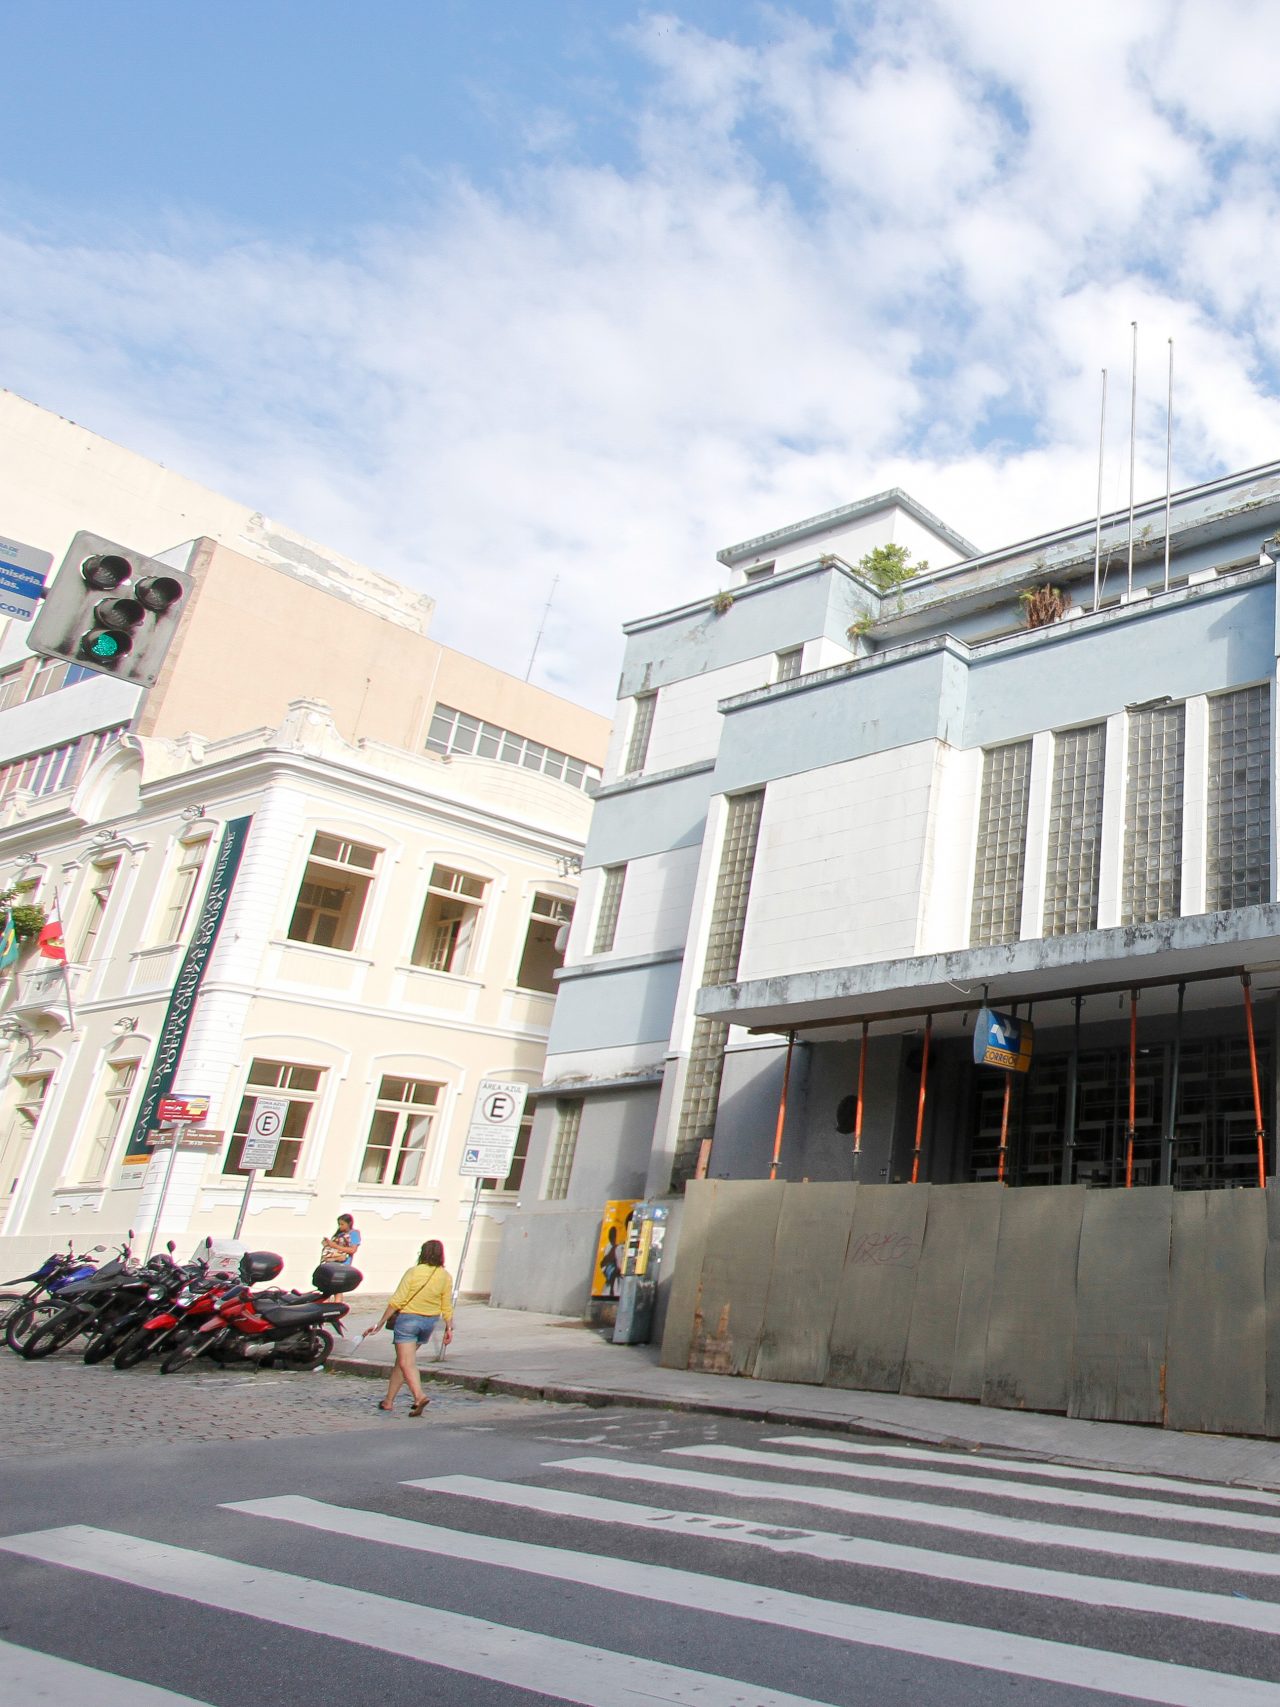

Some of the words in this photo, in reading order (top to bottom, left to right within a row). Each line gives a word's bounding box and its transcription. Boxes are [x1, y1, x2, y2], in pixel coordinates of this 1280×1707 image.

[163, 1013, 187, 1074] POETA
[201, 888, 227, 945] SOUSA
[135, 1092, 157, 1142] CASA
[151, 1062, 165, 1088] DA
[159, 947, 200, 1059] LITERATURA
[262, 1115, 273, 1131] E
[489, 1097, 507, 1118] E
